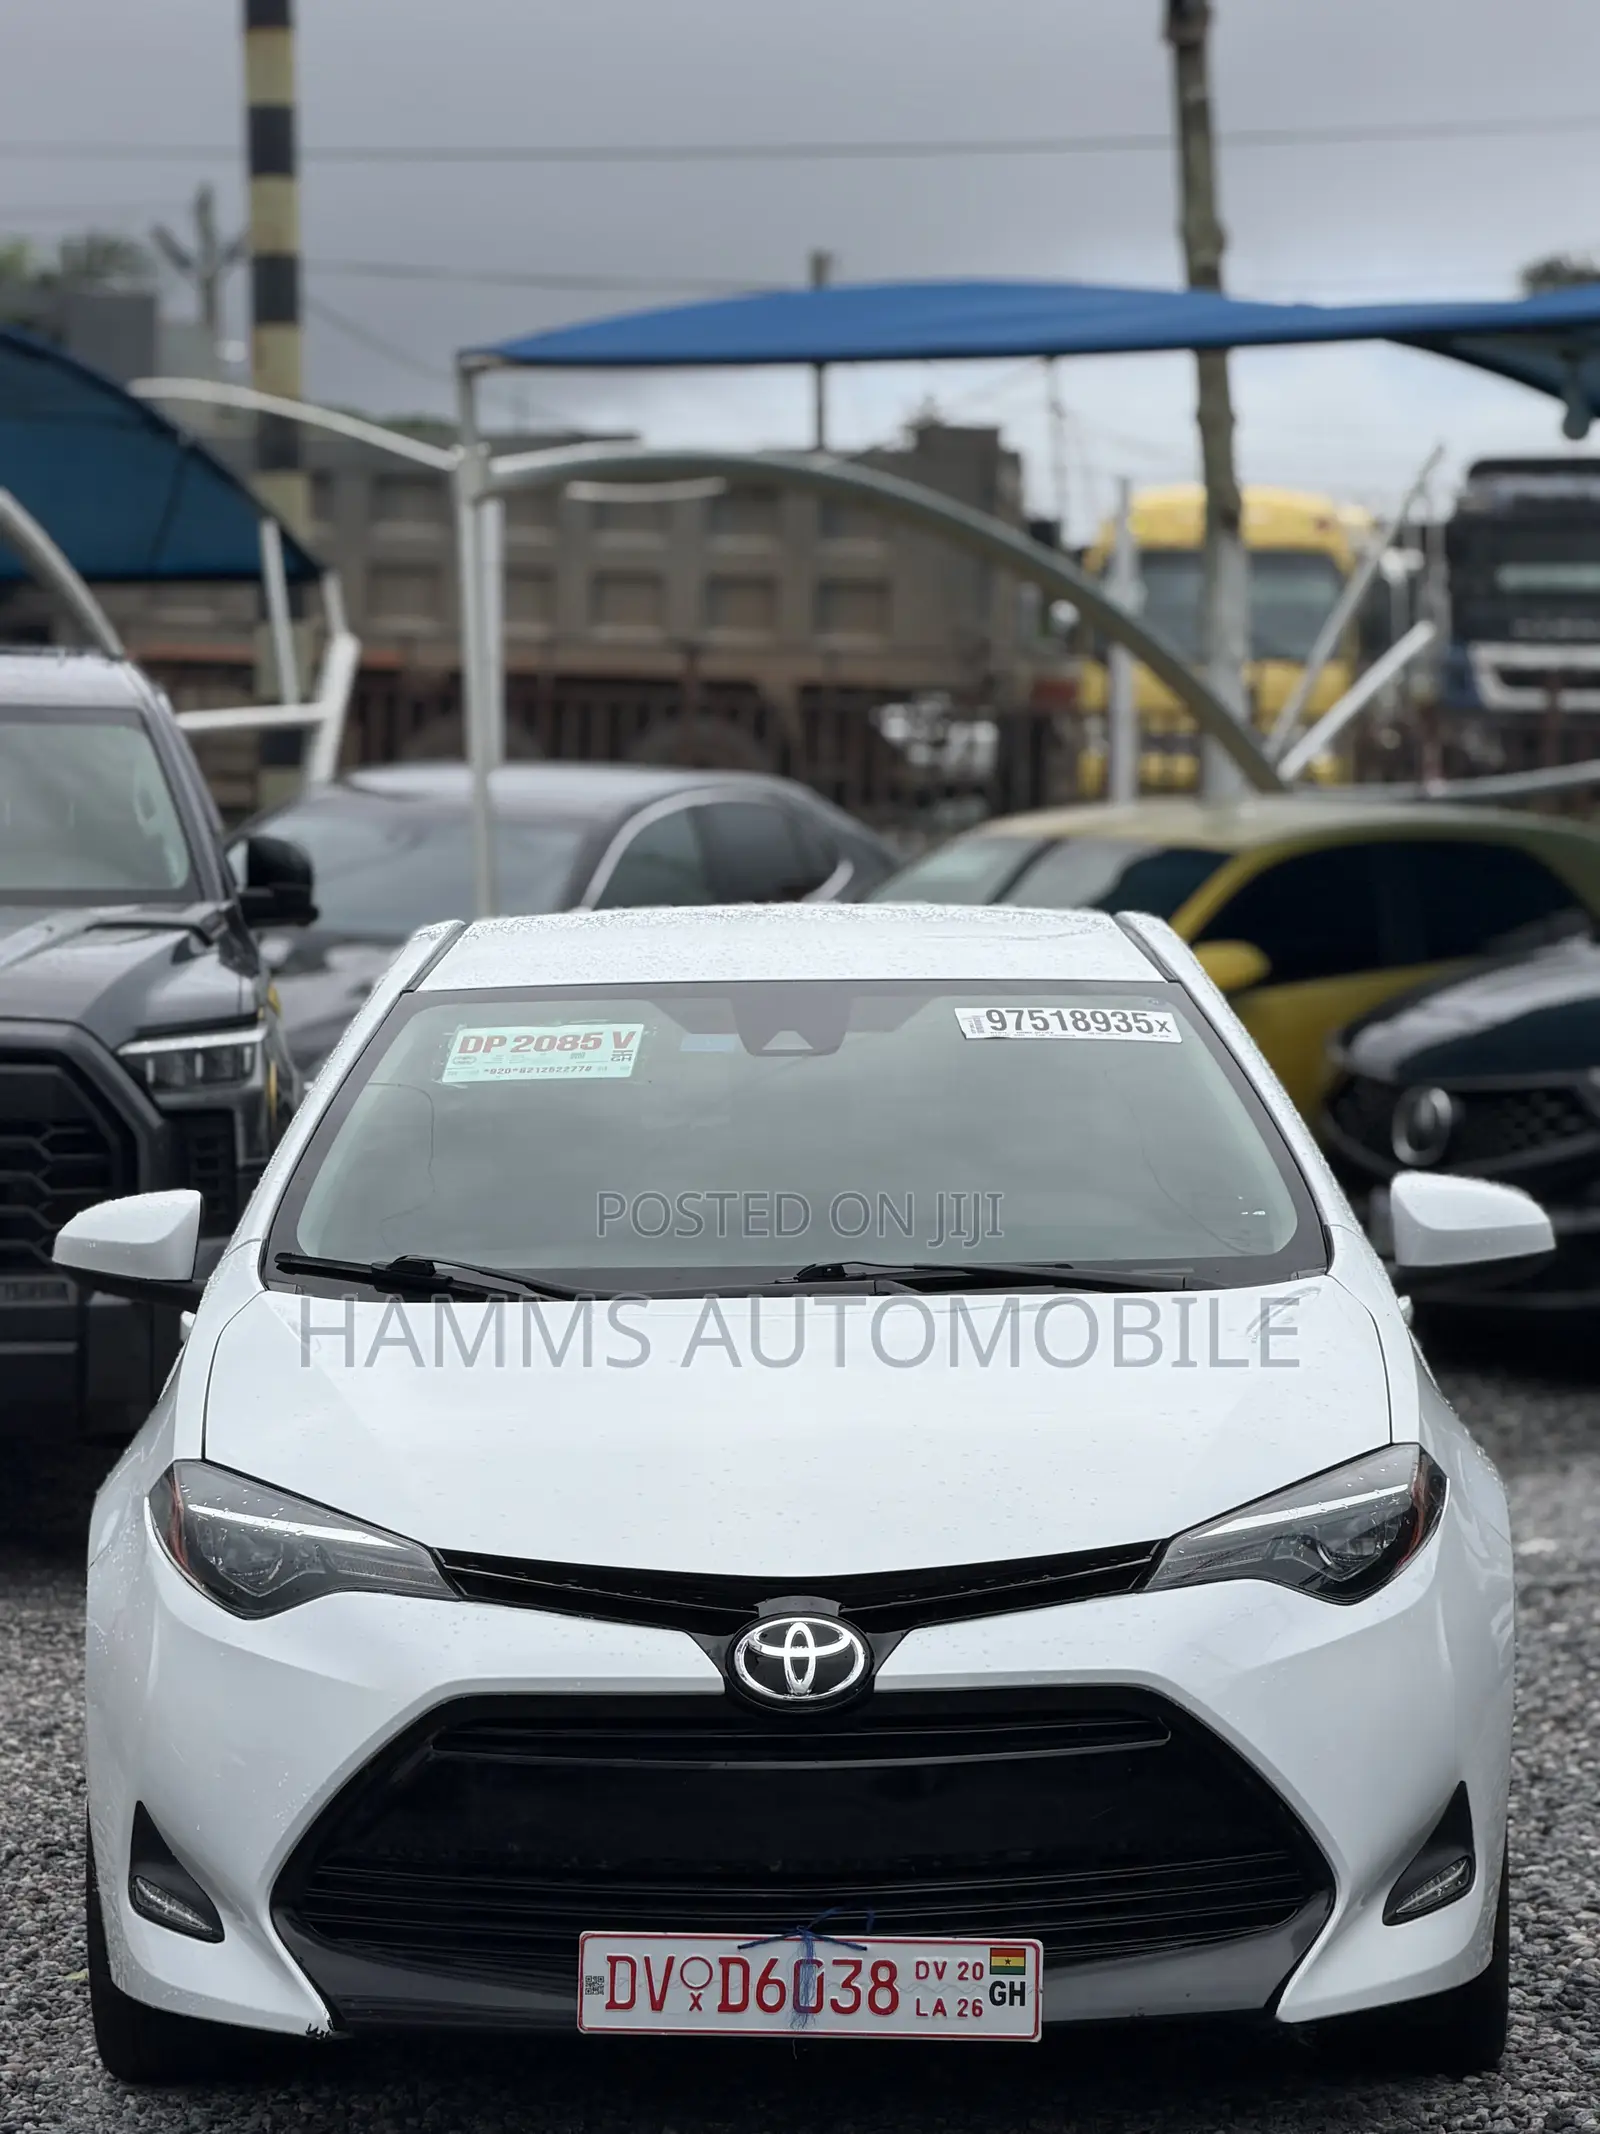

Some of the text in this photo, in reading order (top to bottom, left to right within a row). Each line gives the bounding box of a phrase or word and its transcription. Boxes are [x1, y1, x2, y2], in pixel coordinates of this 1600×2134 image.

[457, 1030, 637, 1054] DP 2085 V
[915, 1960, 985, 1981] DV 20
[605, 1955, 676, 2012] DV
[989, 1980, 1026, 2007] GH
[915, 1998, 984, 2018] LA 26
